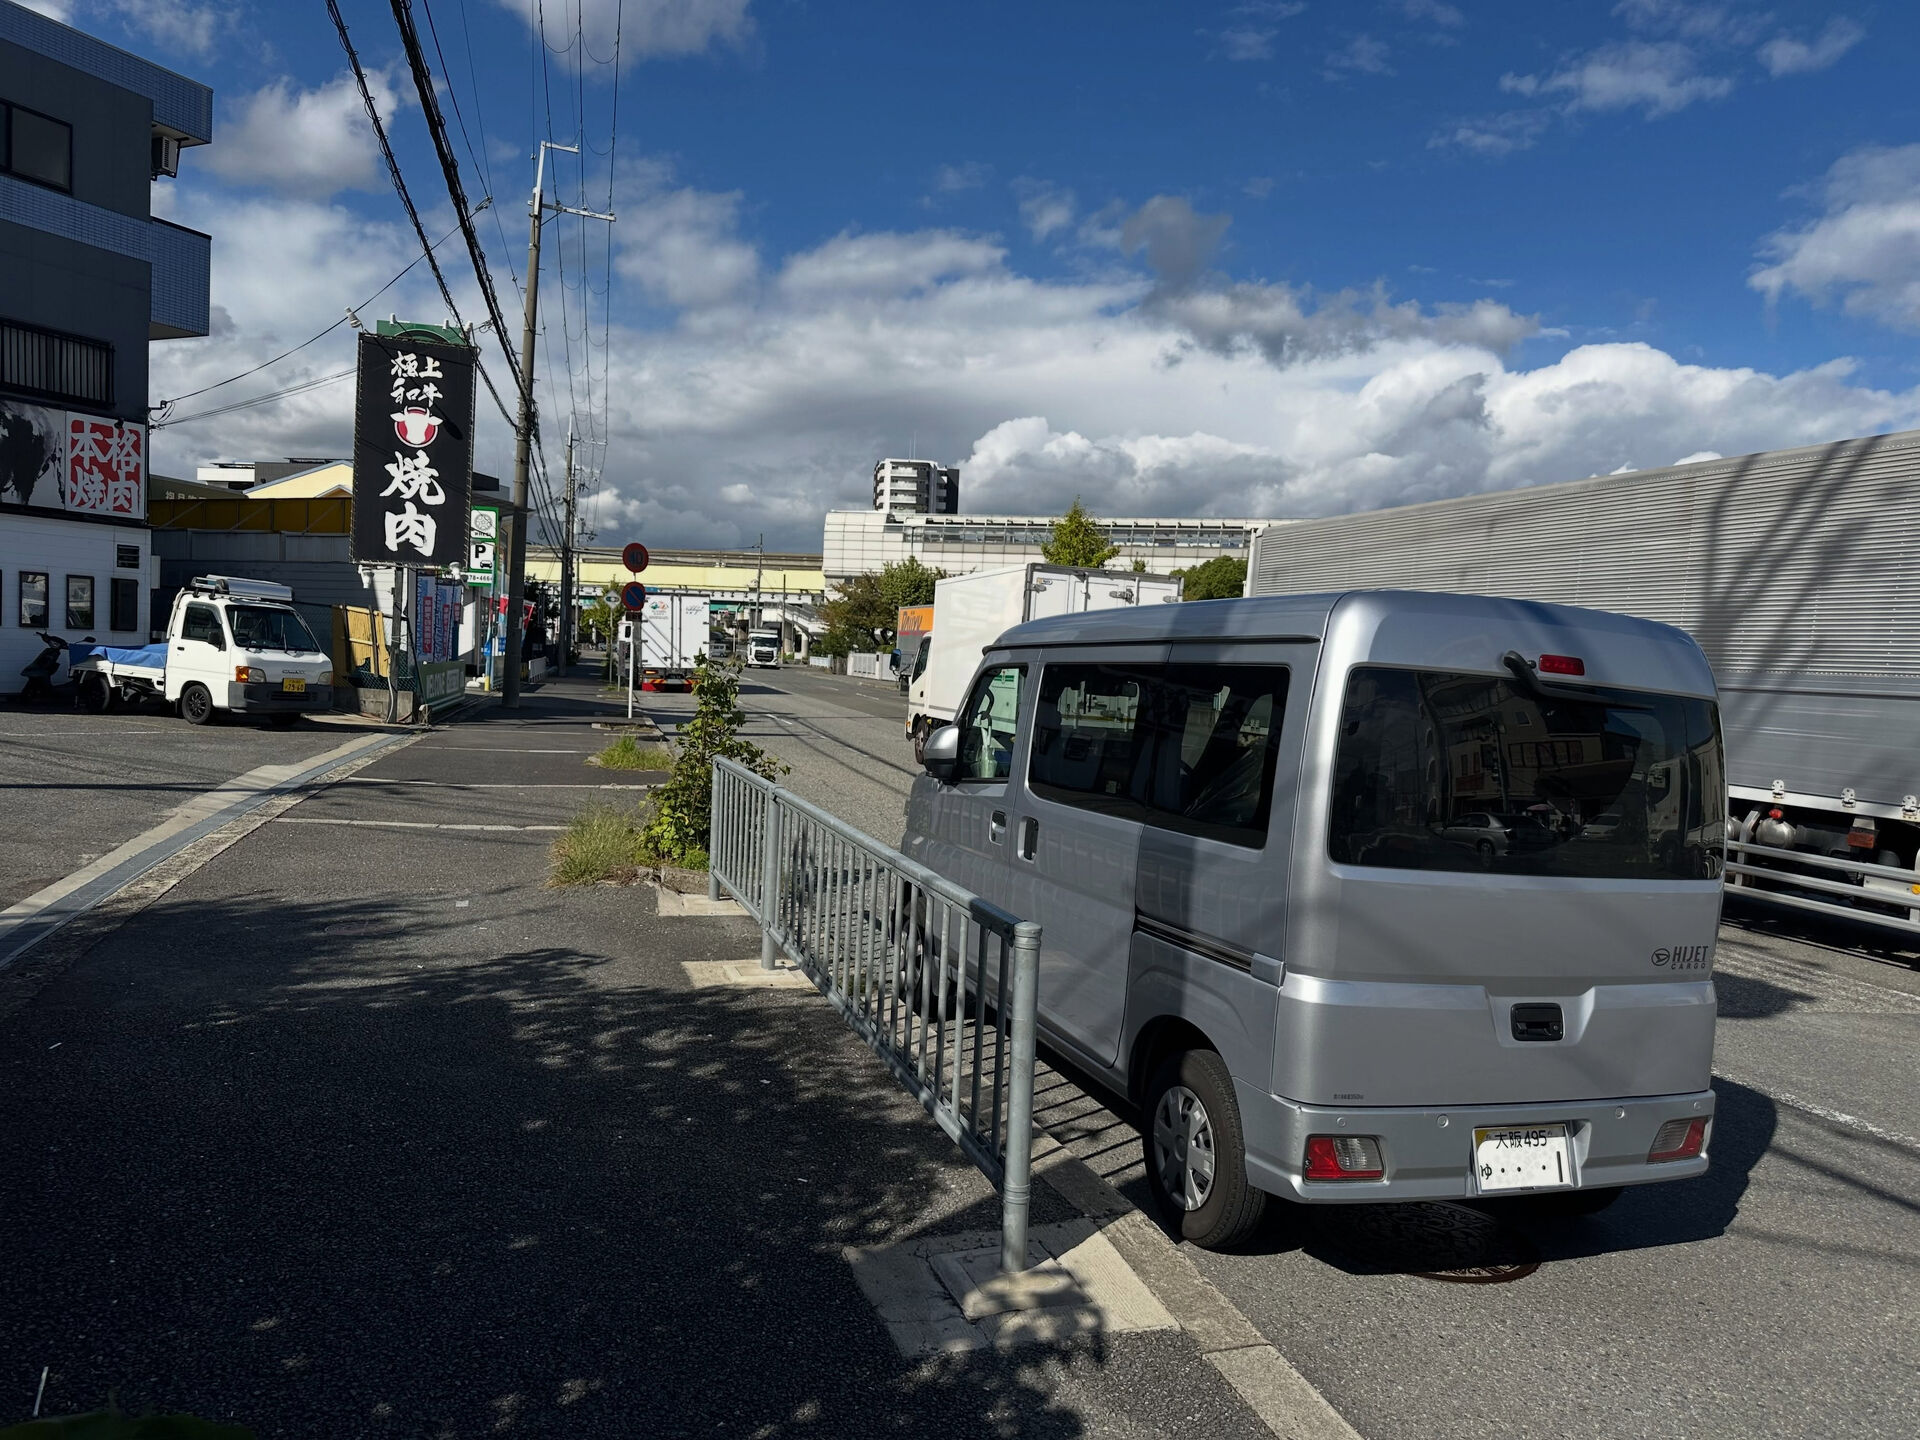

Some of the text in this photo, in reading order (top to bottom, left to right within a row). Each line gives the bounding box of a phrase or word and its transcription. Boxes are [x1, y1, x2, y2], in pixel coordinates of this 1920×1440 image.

[389, 350, 443, 379] 極上
[390, 377, 443, 407] 和牛
[69, 419, 141, 473] 本格
[69, 464, 140, 514] 焼肉
[379, 449, 446, 557] 焼肉
[475, 544, 487, 559] P
[1671, 962, 1706, 970] CARGO
[1672, 945, 1709, 962] HIJET
